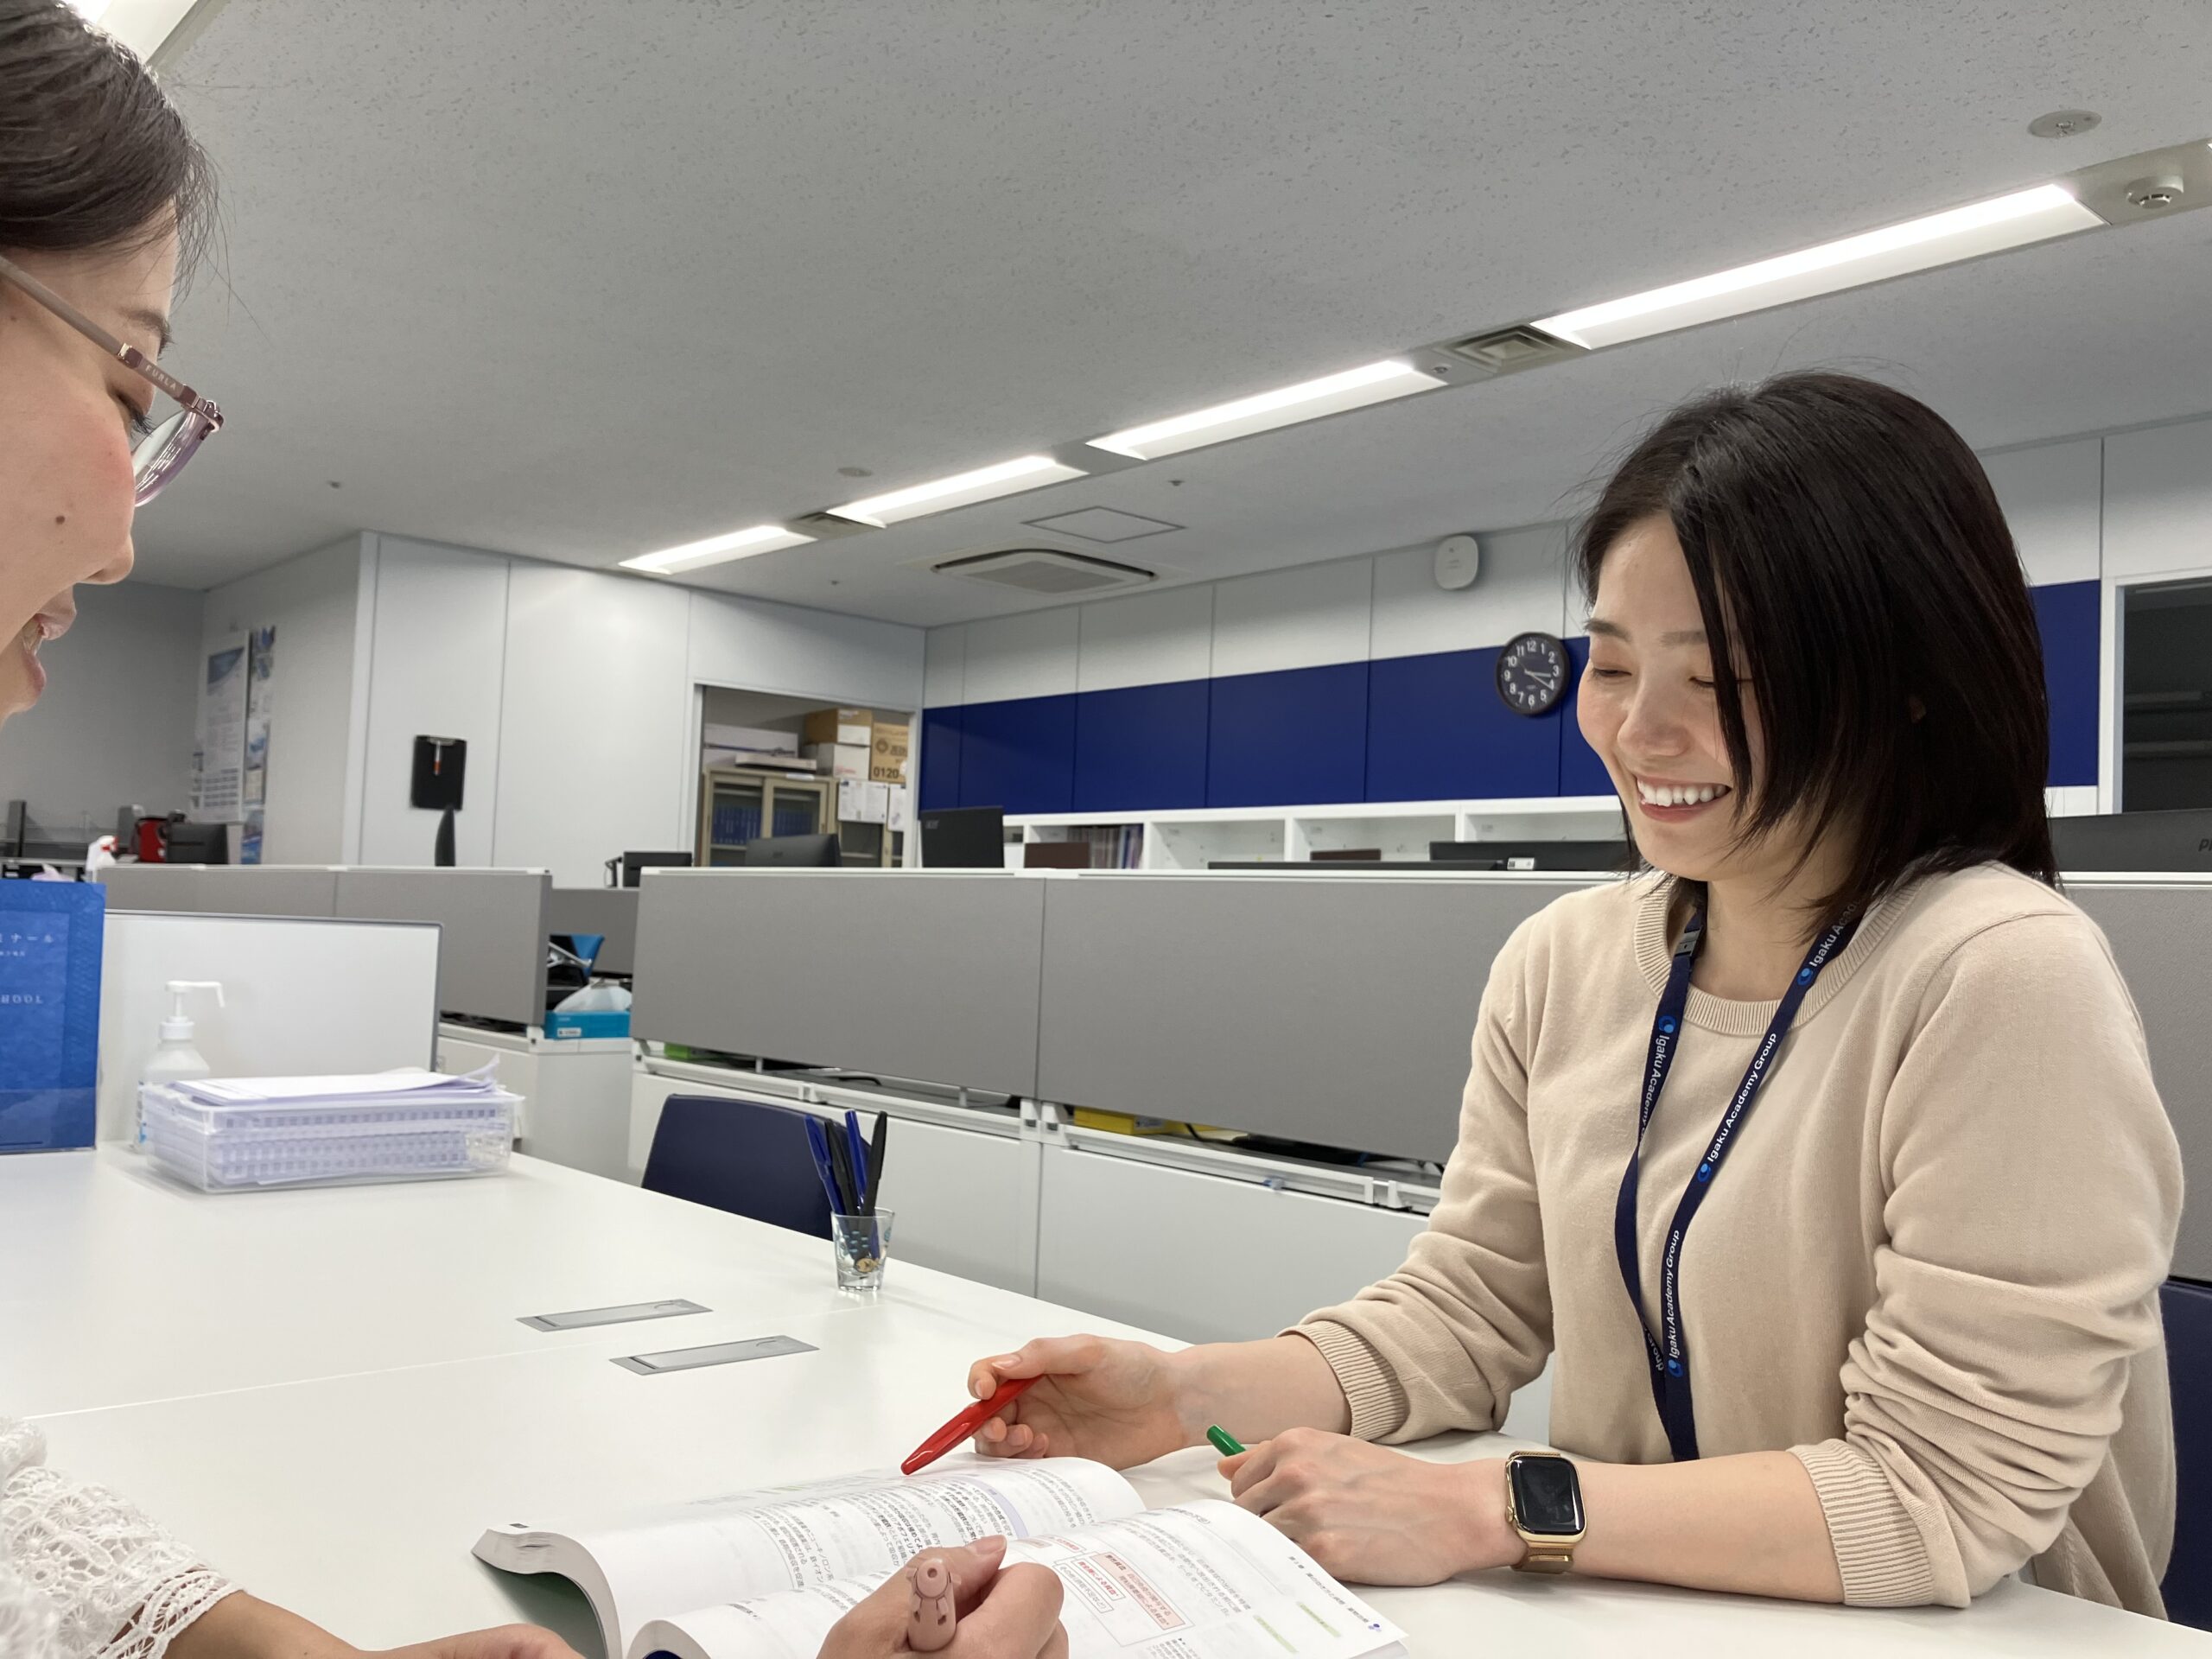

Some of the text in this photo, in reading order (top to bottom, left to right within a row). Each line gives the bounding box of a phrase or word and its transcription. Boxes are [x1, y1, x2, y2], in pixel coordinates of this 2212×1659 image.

[145, 364, 176, 391] FURLA
[1516, 645, 1524, 656] 11
[1526, 639, 1536, 652] 12
[1541, 642, 1545, 655] 1
[1506, 655, 1517, 667] 10
[1548, 651, 1555, 664] 2
[1503, 670, 1510, 681] 9
[1552, 664, 1560, 677] 3
[1509, 683, 1516, 695] 8
[1517, 691, 1524, 703] 7
[1528, 694, 1535, 706] 6
[1540, 690, 1547, 702] 5
[1808, 934, 1837, 967] Igaku
[1642, 1035, 1669, 1126] Igaku Academy
[1707, 1033, 1777, 1162] Igaku Academy Group
[1665, 1230, 1681, 1358] Igaku Academy Group
